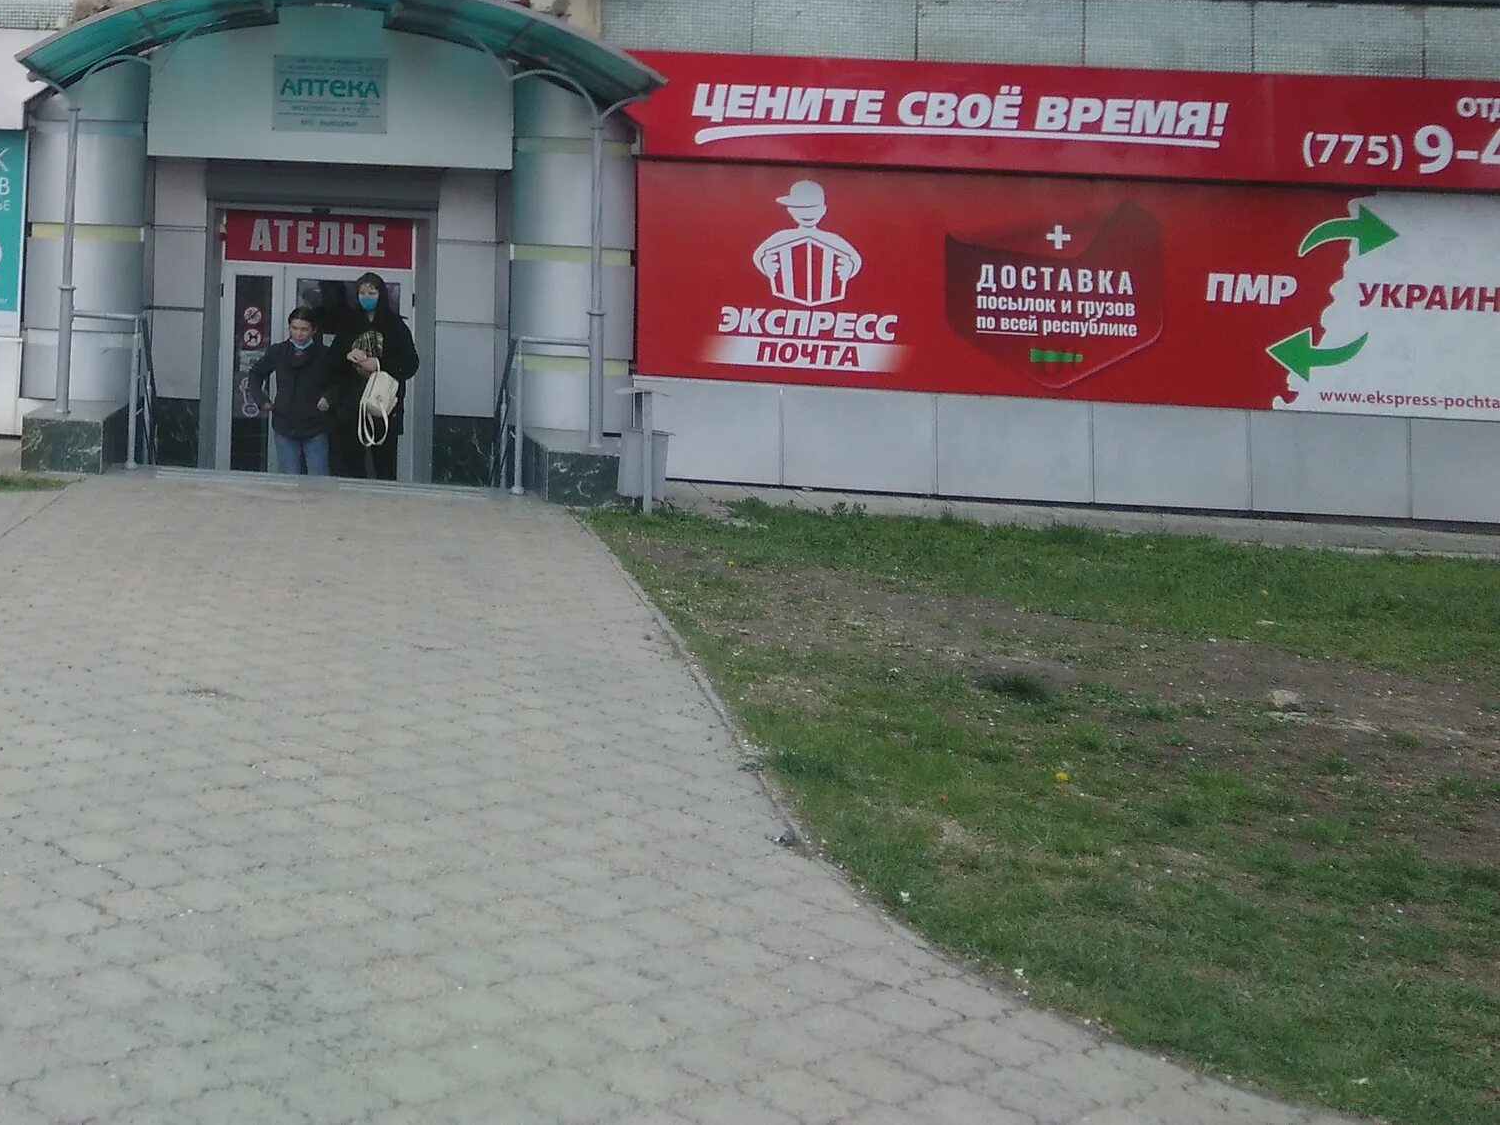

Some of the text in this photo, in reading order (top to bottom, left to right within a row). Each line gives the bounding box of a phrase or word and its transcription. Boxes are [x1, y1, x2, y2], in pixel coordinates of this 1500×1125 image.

[691, 83, 1230, 138] ЦЕНИТЕ СВОЁ ВРЕМЯ!
[1302, 131, 1404, 171] (775)
[250, 217, 386, 259] АТЕЛЬЕ
[976, 264, 1134, 295] ДОСТАВКА
[1206, 273, 1298, 306] ПМР
[976, 295, 1135, 319] посылок и грузов
[718, 307, 898, 341] ЭКСПРЕСС
[976, 315, 1138, 338] по всей республике
[756, 340, 860, 368] ПОЧТА
